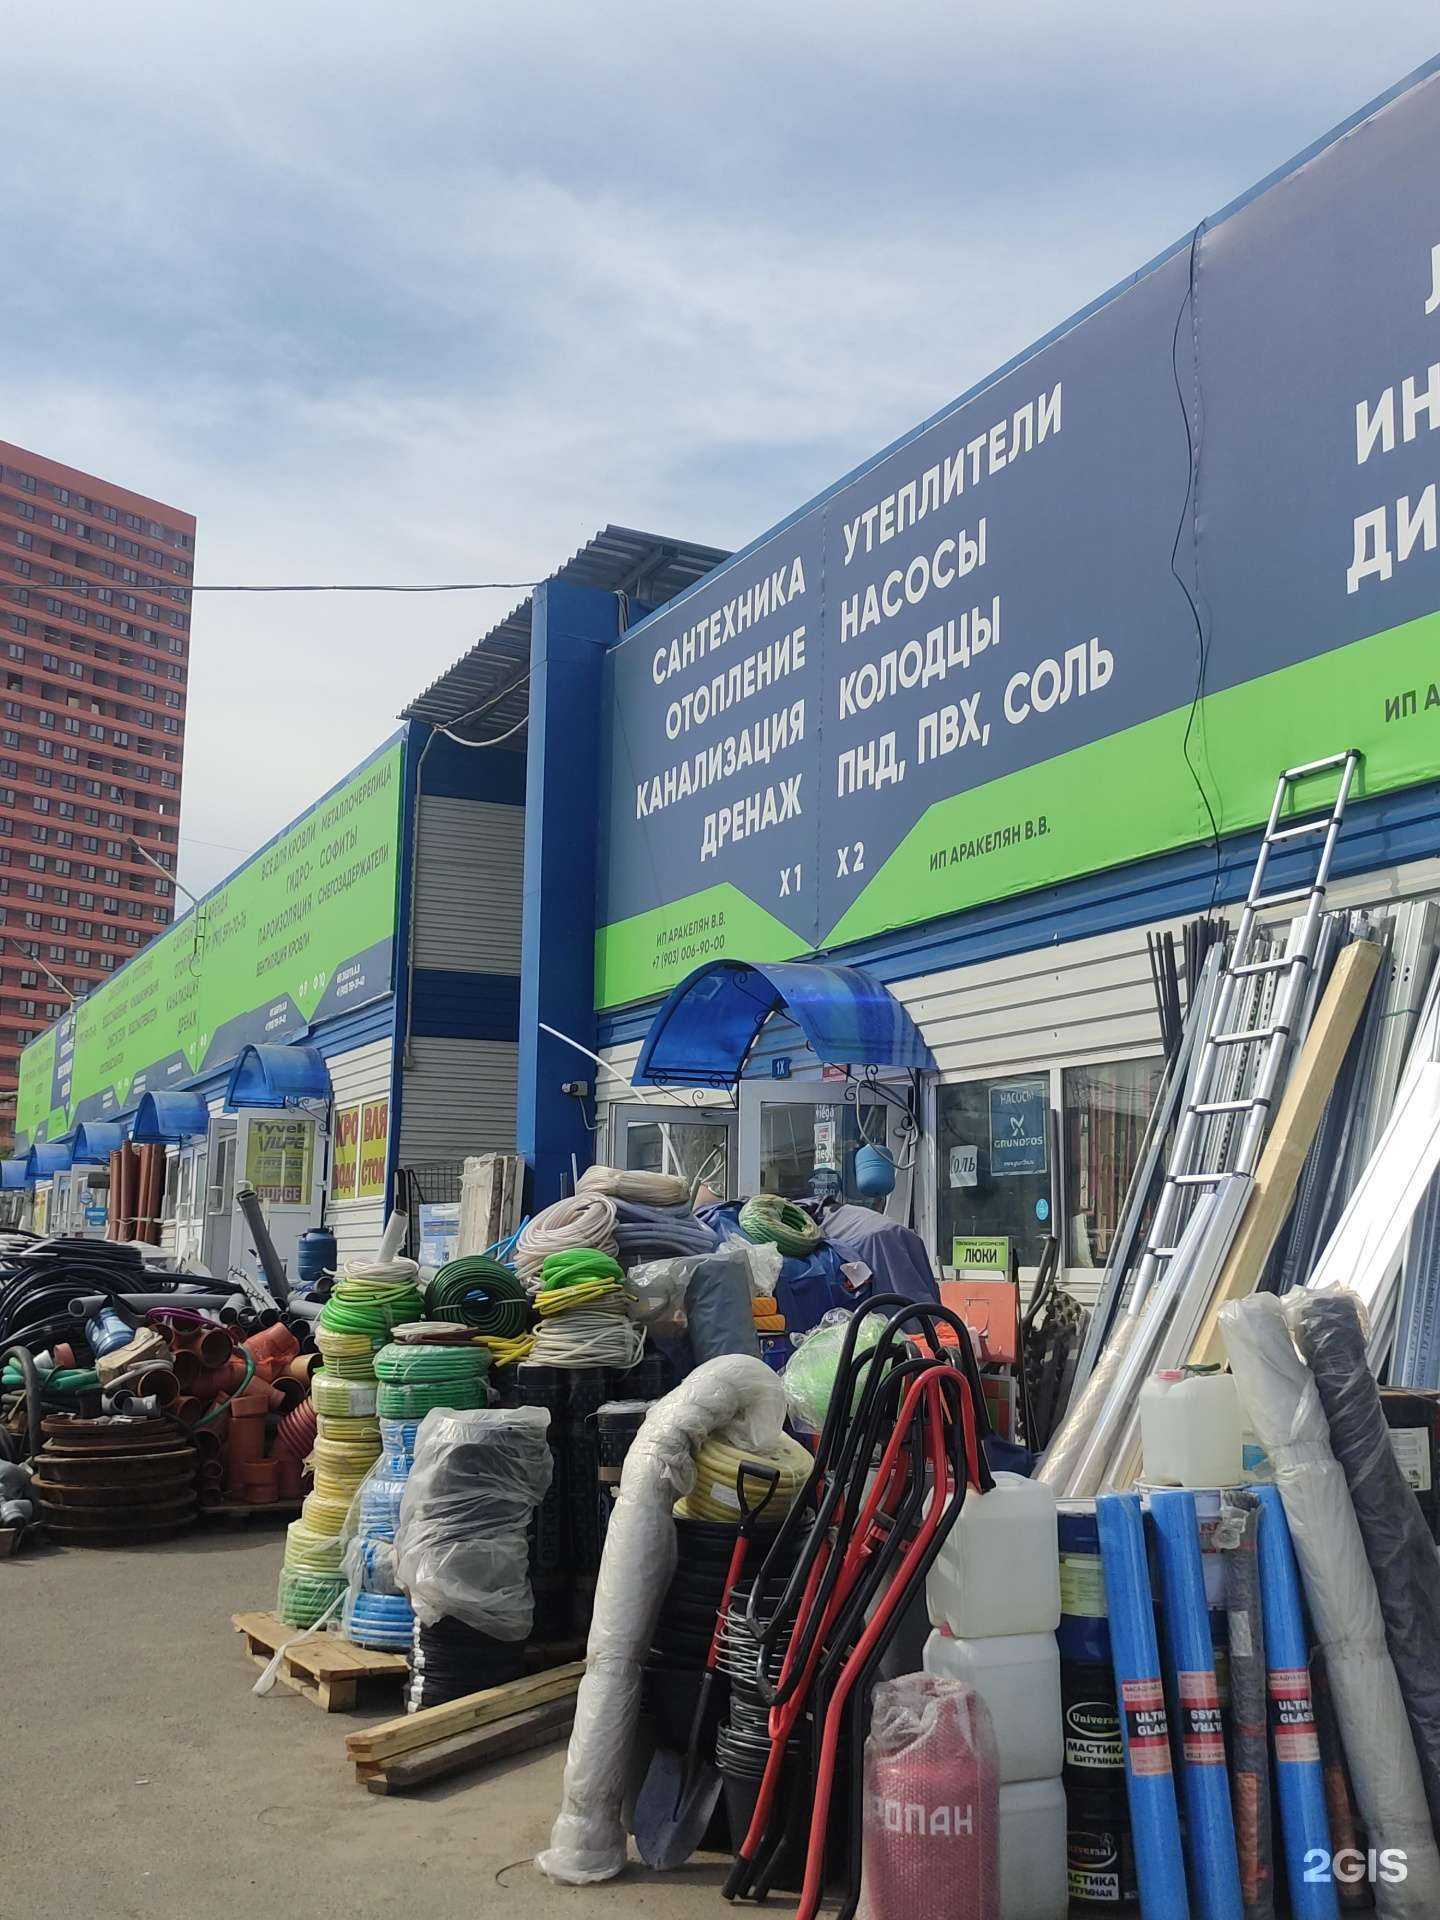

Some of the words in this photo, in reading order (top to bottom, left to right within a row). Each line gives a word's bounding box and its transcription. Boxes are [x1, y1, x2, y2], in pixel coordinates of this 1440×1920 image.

[843, 382, 1062, 566] УТЕПЛИТЕЛИ
[840, 518, 987, 644] НАСОСЫ
[1347, 484, 1437, 594] ДИ
[652, 556, 806, 686] САНТЕХНИКА
[839, 597, 1000, 720] КОЛОДЦЫ
[665, 627, 806, 740] ОТОПЛЕНИЕ
[837, 732, 906, 797] ПНД,
[917, 693, 990, 765] ПВХ,
[1003, 637, 1114, 724] СОЛЬ
[1385, 690, 1416, 722] ИП
[636, 700, 805, 819] КАНАЛИЗАЦИЯ
[320, 824, 358, 869] СОФИТЫ
[701, 774, 802, 861] ДРЕНАЖ
[929, 846, 948, 872] ИП
[950, 828, 1021, 865] АРАКЕЛЯН
[1024, 816, 1051, 844] В.В.
[656, 932, 667, 947] ИП
[668, 916, 710, 943] АРАКЕЛЯН
[681, 934, 725, 960] 006-90-00
[994, 1136, 1043, 1149] GRUNDFOS
[964, 1248, 998, 1263] ЛЮКИ
